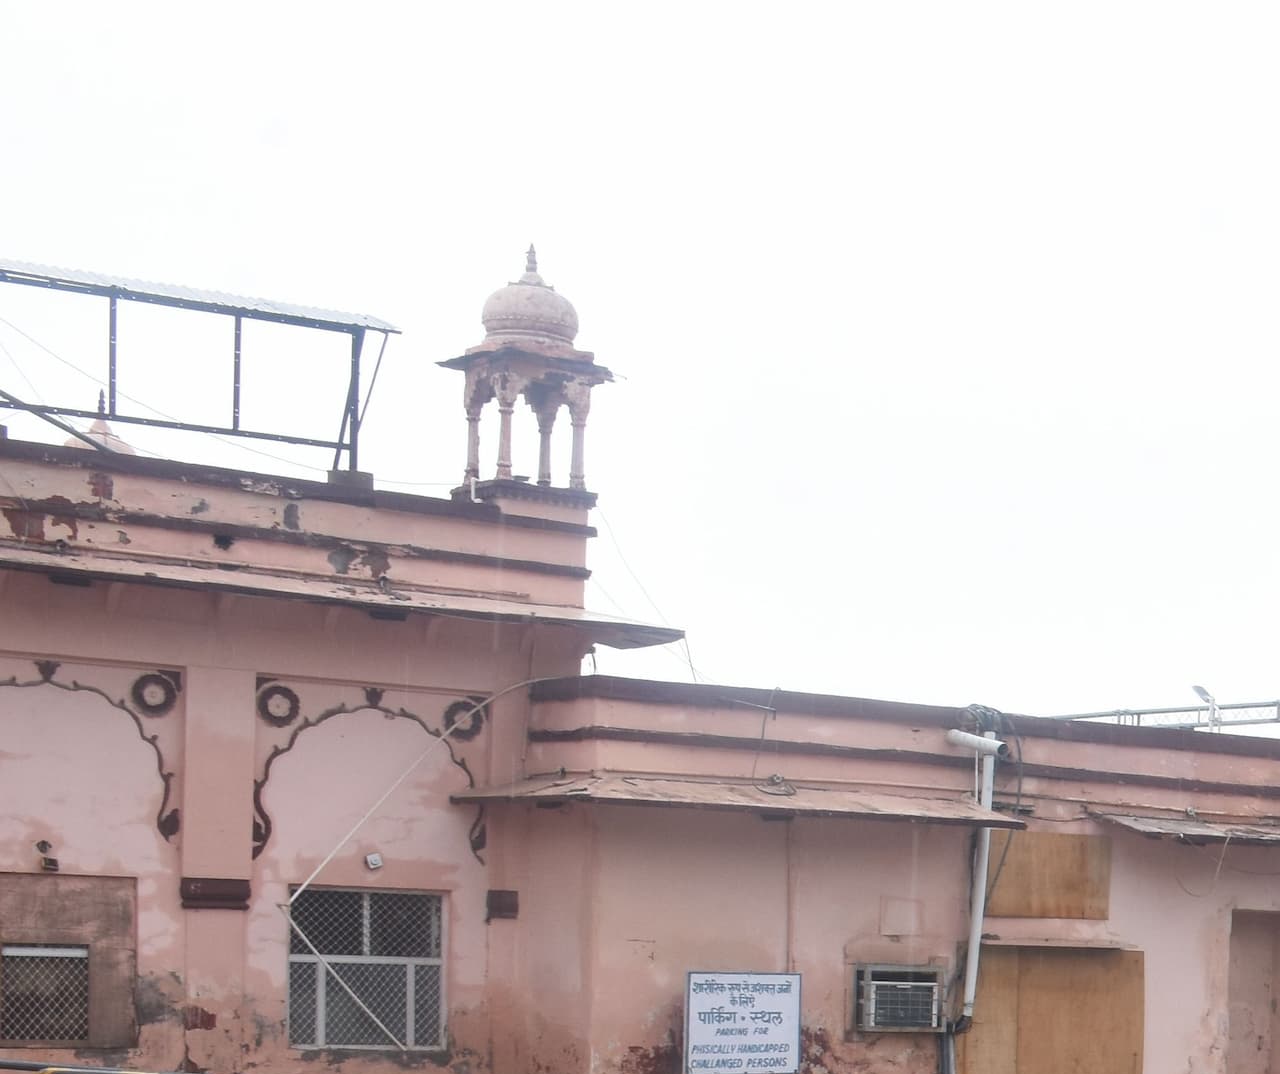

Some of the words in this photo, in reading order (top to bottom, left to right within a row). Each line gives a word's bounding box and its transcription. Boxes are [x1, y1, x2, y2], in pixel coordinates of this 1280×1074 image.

[741, 980, 750, 993] से
[750, 1010, 783, 1026] स्थल
[715, 1027, 748, 1036] PARKING
[753, 1027, 769, 1035] FOR
[737, 1043, 790, 1054] HANDICAPPED
[690, 1058, 743, 1069] CHALLANGED
[746, 1057, 788, 1068] PERSONS
